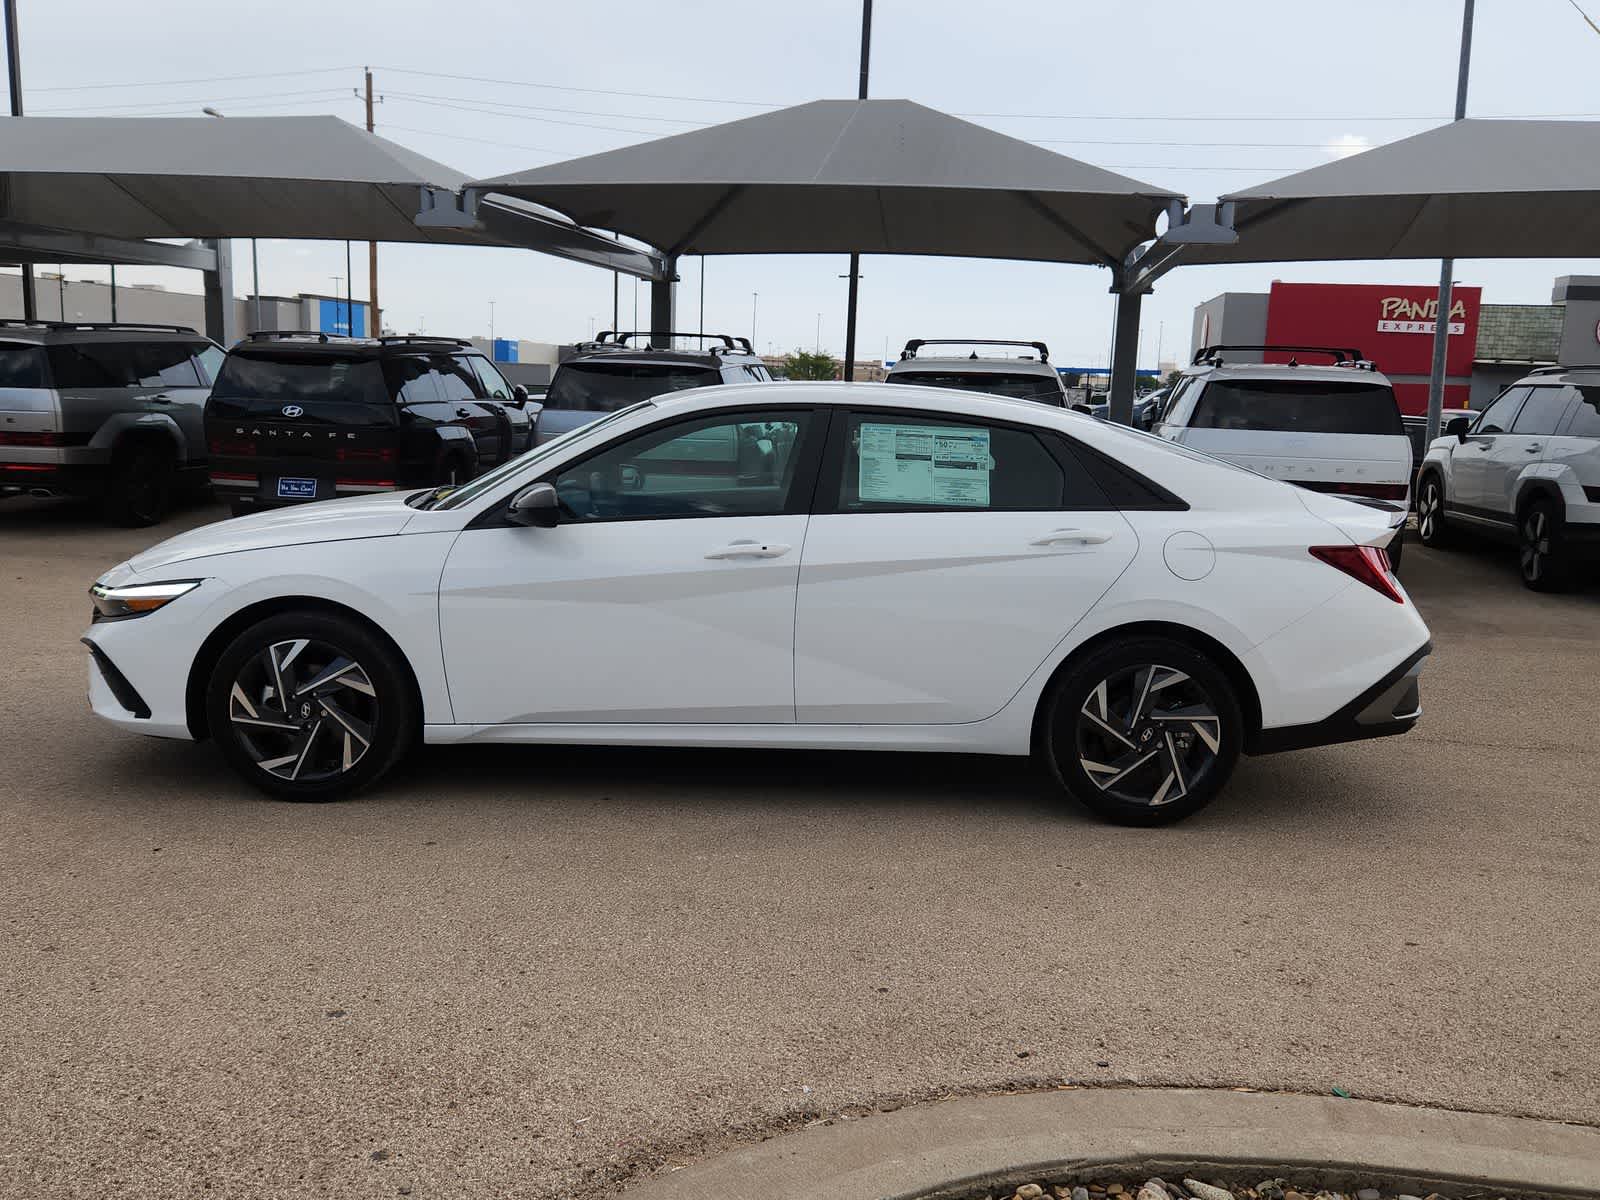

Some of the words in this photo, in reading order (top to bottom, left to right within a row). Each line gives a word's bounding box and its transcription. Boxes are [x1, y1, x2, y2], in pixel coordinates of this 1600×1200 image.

[1381, 297, 1466, 319] PANDA
[1382, 322, 1461, 333] EXPRES
[236, 428, 312, 438] SANTA
[1246, 464, 1316, 472] ANTA
